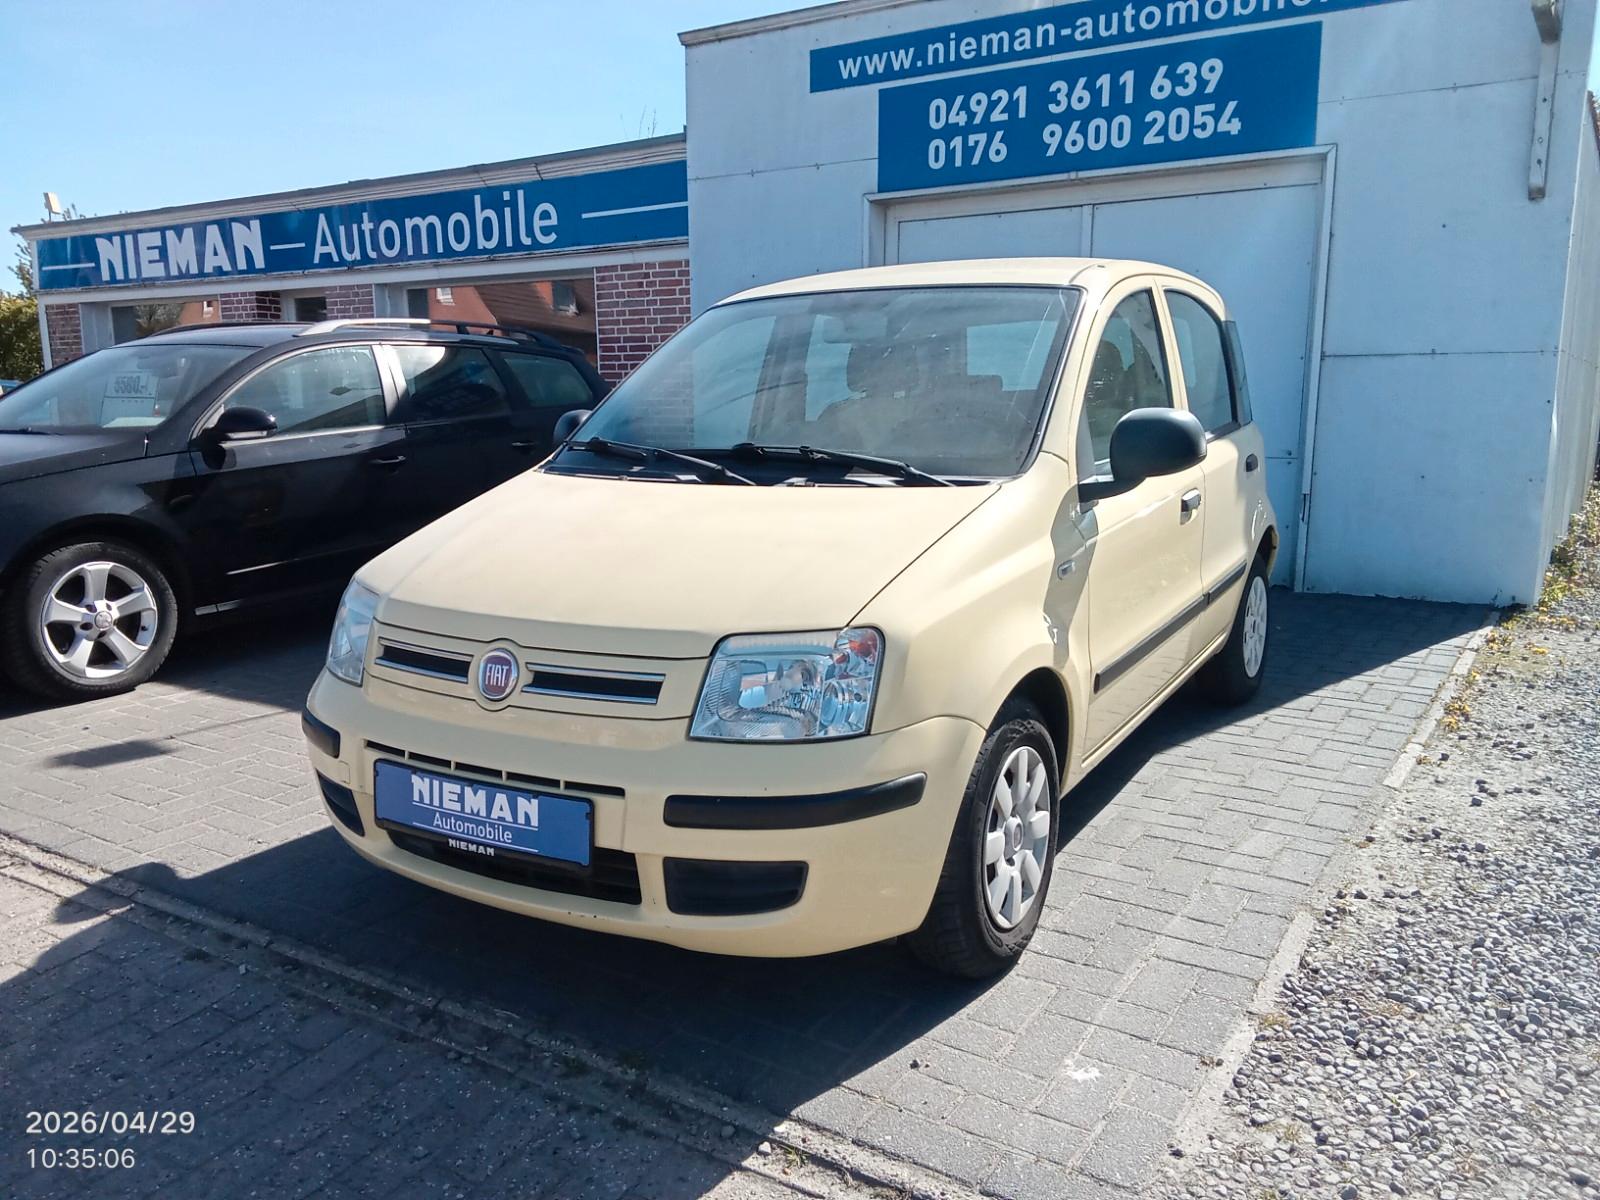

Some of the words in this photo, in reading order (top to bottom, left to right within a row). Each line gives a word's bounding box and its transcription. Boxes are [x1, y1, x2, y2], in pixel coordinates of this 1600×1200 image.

[928, 86, 1028, 130] 04921
[1048, 70, 1135, 114] 3611
[1149, 58, 1224, 99] 639
[928, 130, 1008, 170] 0176
[1042, 114, 1132, 157] 9600
[1143, 100, 1242, 145] 2054
[96, 219, 266, 283] NIEMAN
[313, 190, 559, 264] Automobile
[485, 663, 509, 687] FIAT
[411, 774, 539, 827] NIEMAN
[433, 812, 513, 844] Automobile
[448, 838, 495, 857] NIEMAN
